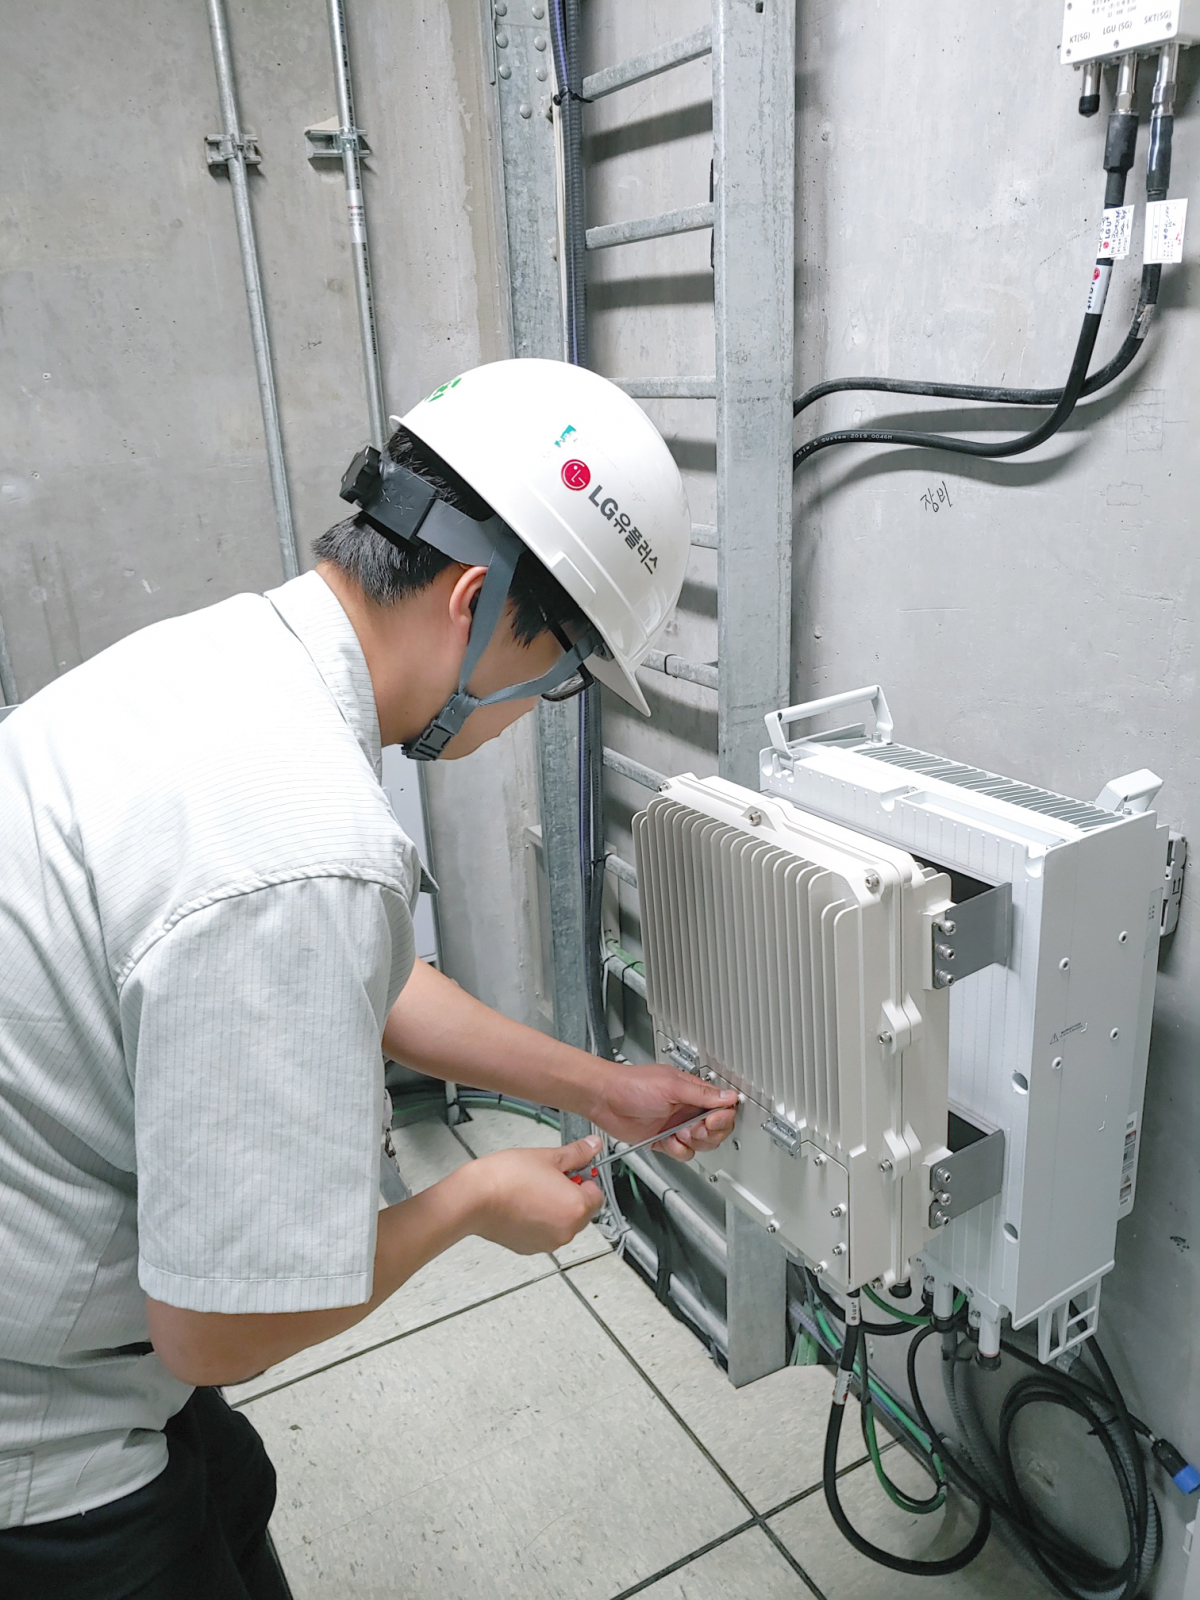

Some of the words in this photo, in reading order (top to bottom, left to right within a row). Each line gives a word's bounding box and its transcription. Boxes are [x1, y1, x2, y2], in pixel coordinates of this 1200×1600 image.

[1103, 25, 1117, 35] LGU
[920, 481, 953, 513] 장비
[588, 485, 658, 575] LG유플러스
